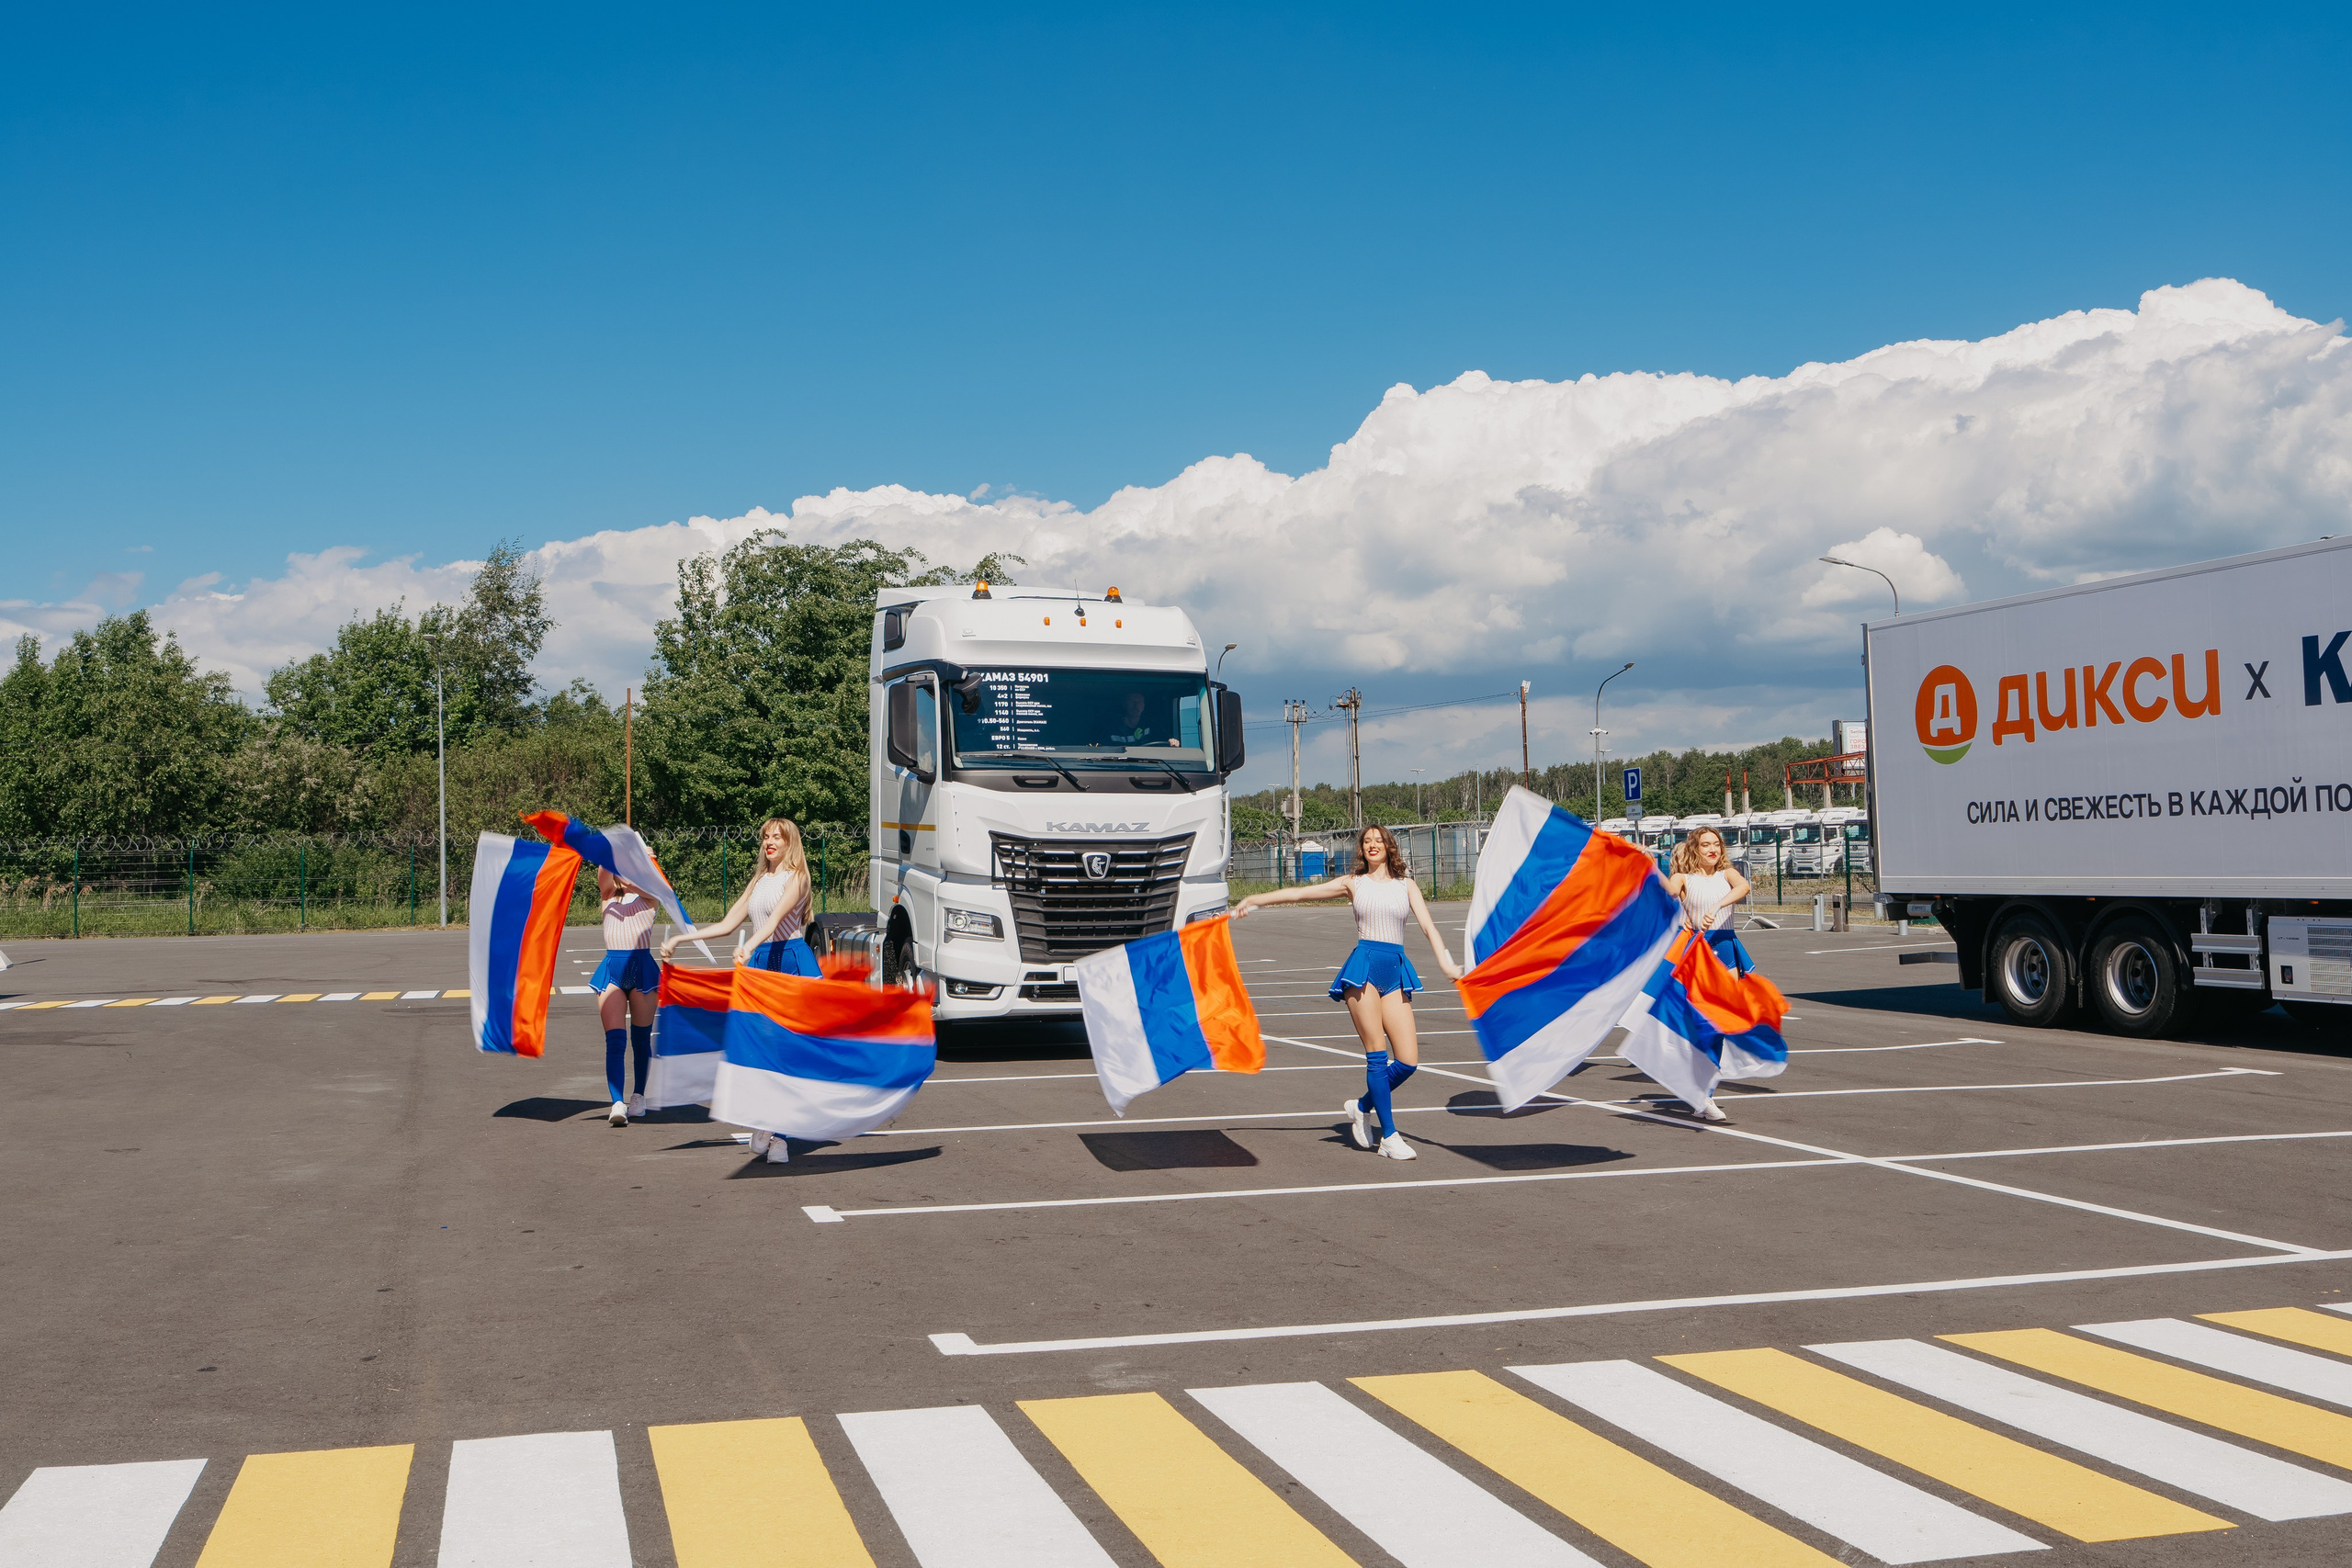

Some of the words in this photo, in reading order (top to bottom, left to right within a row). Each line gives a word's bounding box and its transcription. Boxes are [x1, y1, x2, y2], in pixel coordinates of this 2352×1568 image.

[1018, 673, 1049, 683] 54901
[1992, 649, 2221, 746] ДИКСИ
[1627, 772, 1638, 797] P
[1967, 800, 2020, 825] СИЛА
[2025, 798, 2039, 822] И
[2044, 793, 2162, 822] СВЕЖЕСТЬ
[2168, 791, 2184, 817] В
[2190, 776, 2307, 820] КАЖДОЙ
[1046, 821, 1150, 833] KAMAZ
